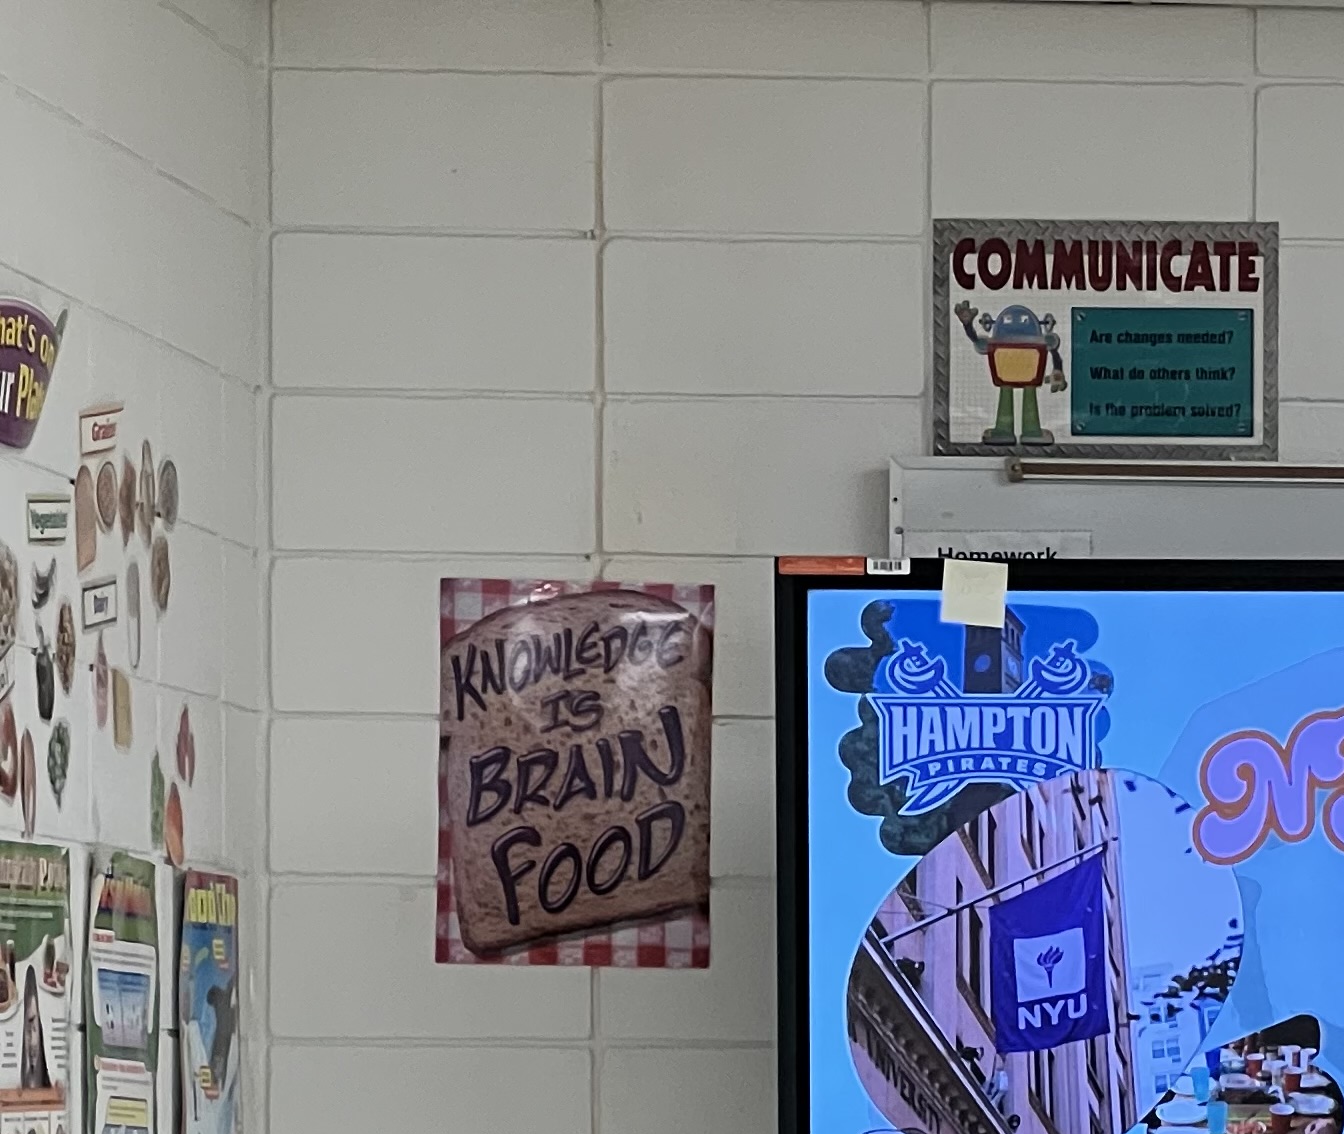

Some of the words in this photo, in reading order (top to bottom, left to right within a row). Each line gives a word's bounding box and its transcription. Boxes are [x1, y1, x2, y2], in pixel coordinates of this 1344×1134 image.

[952, 237, 1260, 293] COMMUNICATE
[1089, 329, 1112, 344] Are
[1117, 330, 1173, 346] changes
[1177, 329, 1234, 344] needed?
[1089, 367, 1124, 380] What
[1128, 367, 1145, 380] do
[1150, 367, 1190, 381] others
[1196, 366, 1236, 381] think?
[1089, 402, 1101, 416] Is
[1105, 402, 1126, 416] the
[1131, 403, 1186, 418] problem
[1190, 403, 1241, 417] solved?
[451, 620, 684, 721] KNOWLEDGE
[540, 689, 604, 733] IS
[889, 705, 1086, 766] HAMPTON
[466, 705, 684, 827] BRAIN
[928, 756, 1046, 777] PIRATES
[491, 800, 685, 925] FOOD
[1017, 992, 1088, 1030] NYU
